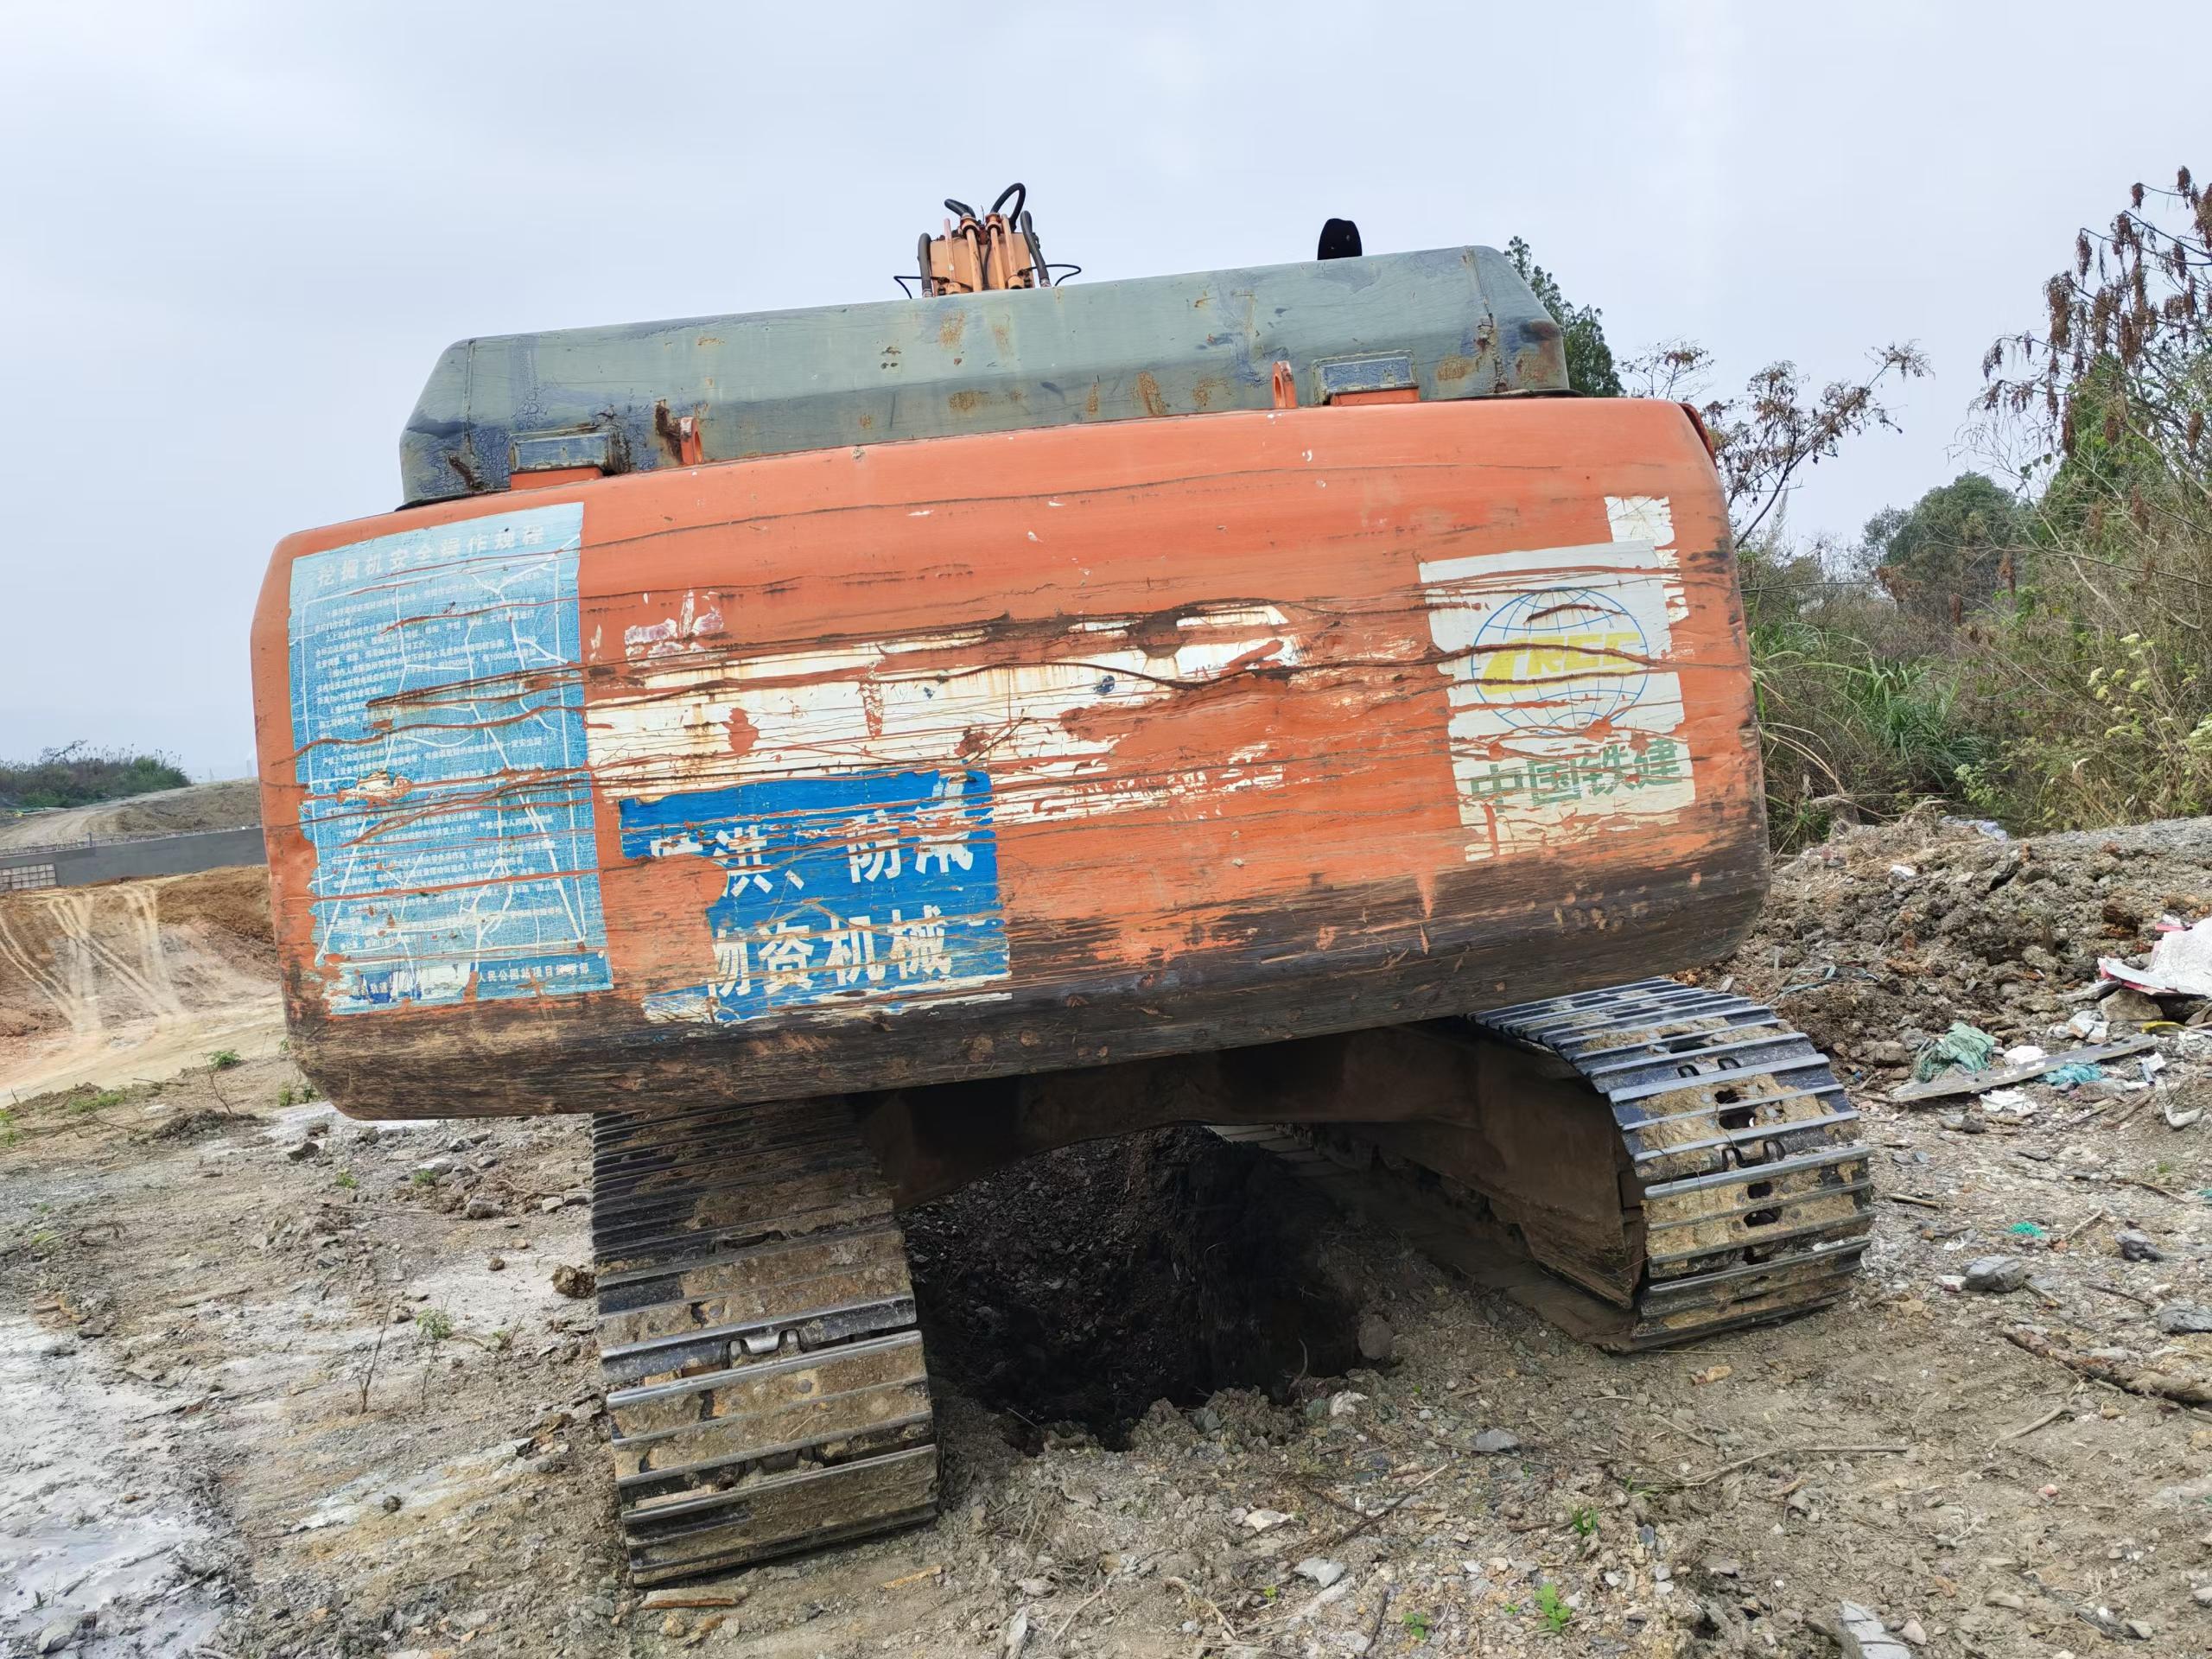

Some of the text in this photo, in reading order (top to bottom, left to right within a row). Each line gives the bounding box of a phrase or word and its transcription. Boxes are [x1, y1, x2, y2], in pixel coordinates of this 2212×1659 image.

[317, 525, 543, 587] 挖掘机安全操作规程
[1470, 738, 1681, 814] 中国铁建
[707, 905, 952, 998] 物资机械
